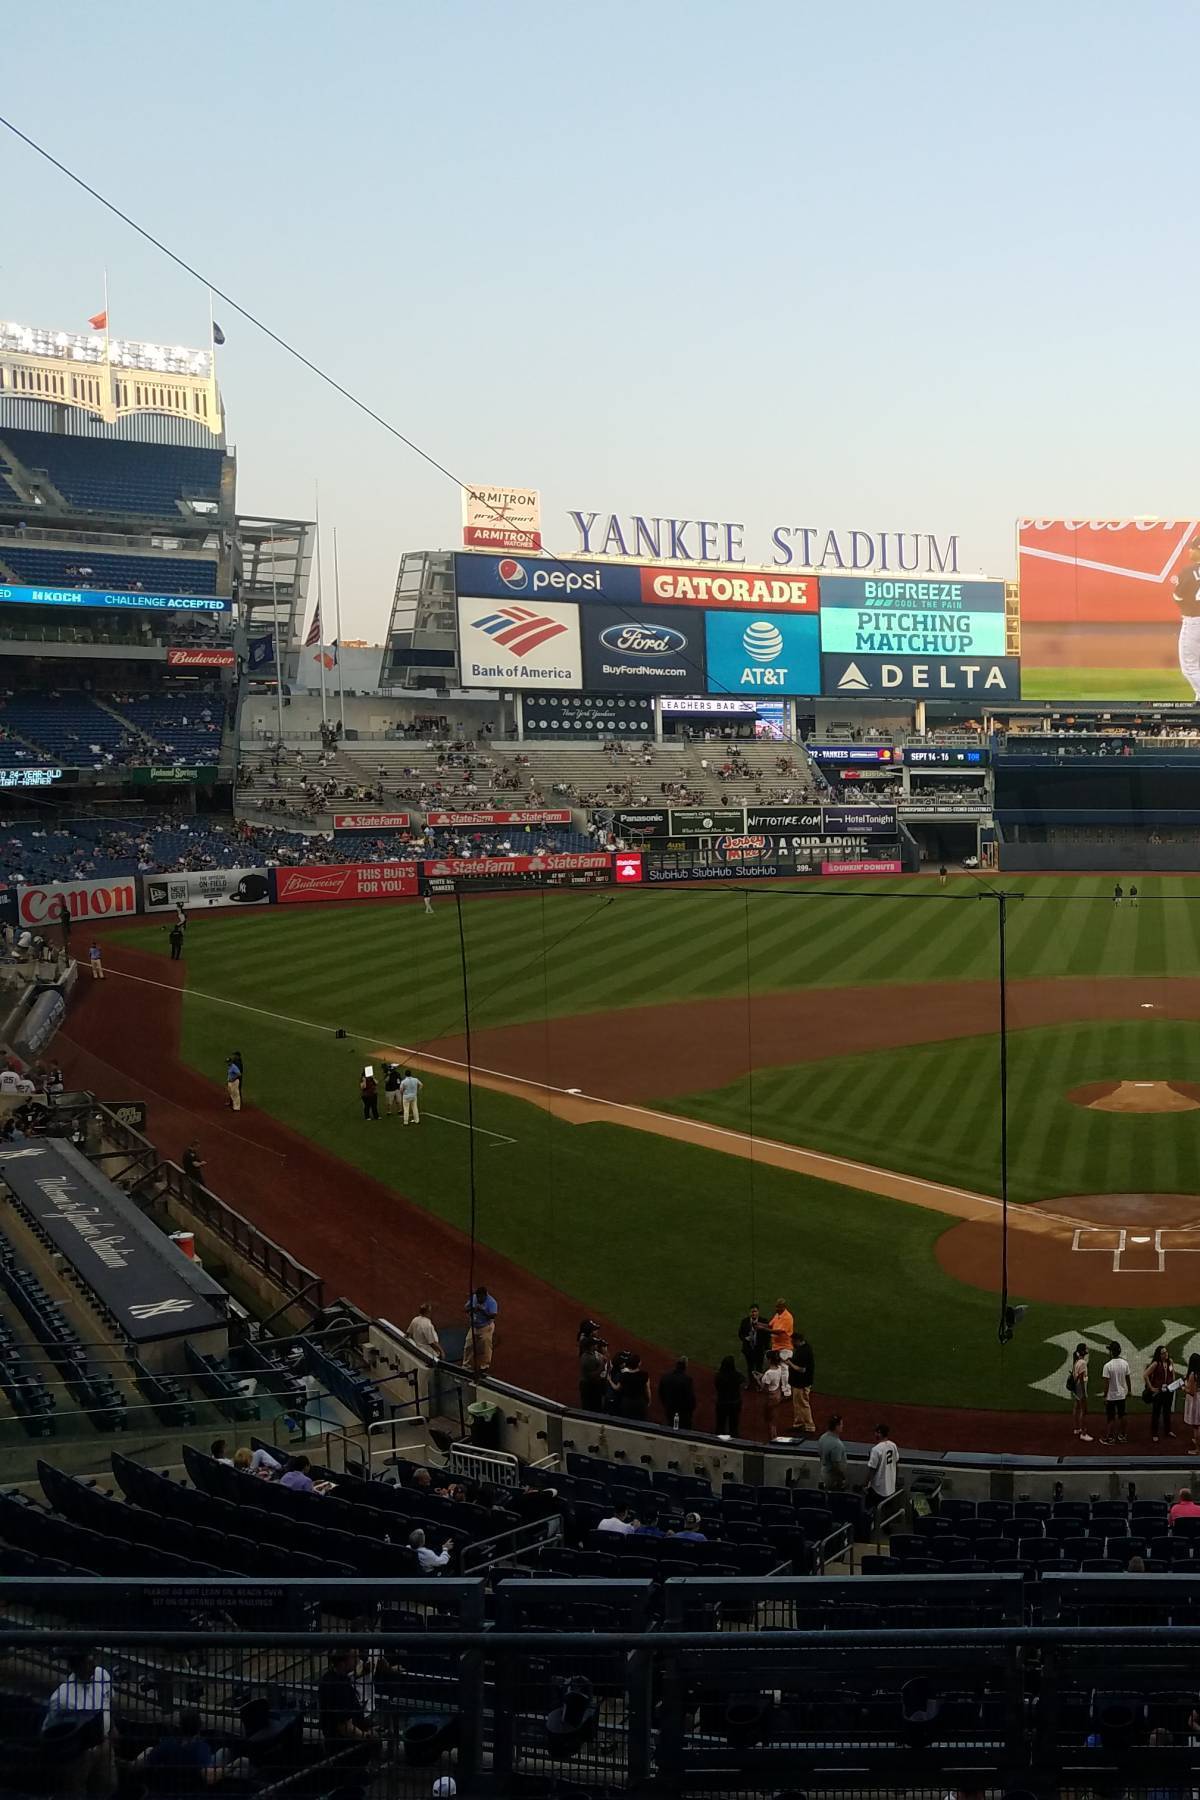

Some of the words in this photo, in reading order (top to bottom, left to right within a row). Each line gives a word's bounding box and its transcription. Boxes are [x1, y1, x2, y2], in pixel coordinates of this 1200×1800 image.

[469, 491, 537, 506] ARMITRON
[474, 530, 535, 542] ARMITRON
[567, 510, 746, 563] YANKEE
[772, 528, 960, 573] STADIUM
[503, 540, 534, 549] WATCHES
[533, 569, 602, 594] pepsi
[653, 575, 808, 605] GATORADE
[41, 592, 82, 602] KOCH
[105, 595, 166, 607] CHALLENGE
[167, 598, 225, 610] ACCEPTED
[858, 612, 972, 633] PITCHING
[617, 628, 670, 652] Ford
[855, 632, 974, 654] MATCHUP
[171, 651, 234, 664] Budweiser
[472, 663, 504, 677] Bank
[506, 664, 519, 677] of
[520, 665, 571, 680] America
[603, 663, 686, 679] BuyFordNow.com
[740, 668, 788, 685] AT&T
[881, 664, 1009, 690] DELTA
[717, 702, 735, 710] BAR
[911, 752, 928, 761] SEPT
[928, 752, 937, 761] 14
[620, 813, 664, 822] Panasonic
[357, 869, 381, 880] THIS
[384, 867, 416, 879] BUD'S
[649, 869, 689, 880] StubHub
[692, 867, 732, 878] StubHub
[735, 865, 777, 876] StubHub
[289, 877, 345, 890] Budweiser
[358, 881, 378, 893] FOR
[20, 885, 134, 922] Canon
